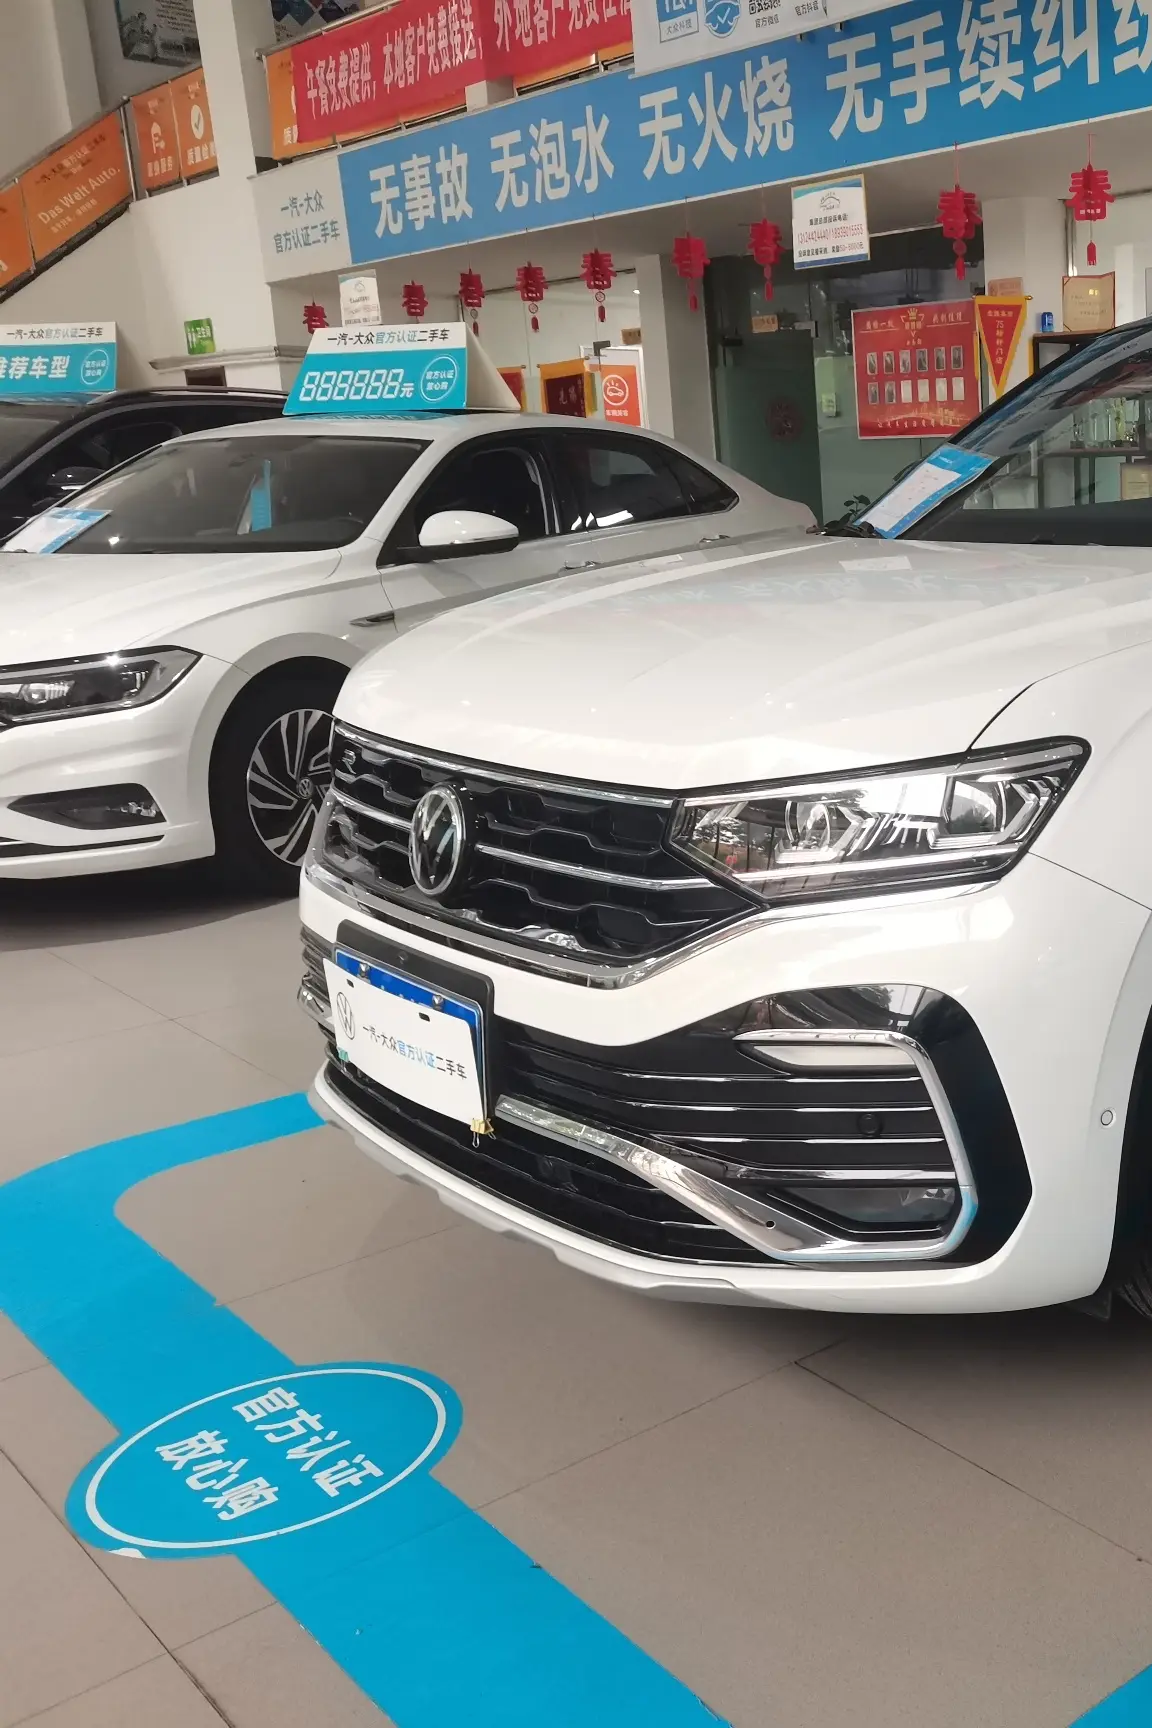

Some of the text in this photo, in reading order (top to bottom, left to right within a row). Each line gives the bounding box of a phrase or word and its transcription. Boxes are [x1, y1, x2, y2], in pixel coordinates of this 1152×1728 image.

[369, 142, 474, 239] 无事故
[489, 104, 615, 213] 无泡水
[637, 55, 795, 181] 无火烧
[61, 182, 91, 208] Welt
[280, 189, 324, 218] 一汽-大众
[273, 220, 341, 253] 官方认证二手车
[6, 327, 104, 340] 一汽-大众官方认证二手车
[327, 328, 450, 346] 一汽-大众官方认证二手车
[426, 370, 454, 379] 官方认证
[426, 382, 449, 391] 放心购
[362, 1025, 468, 1080] 一汽-大众官方认证二手车
[231, 1386, 385, 1498] 官方认证
[154, 1429, 280, 1521] 放心购
